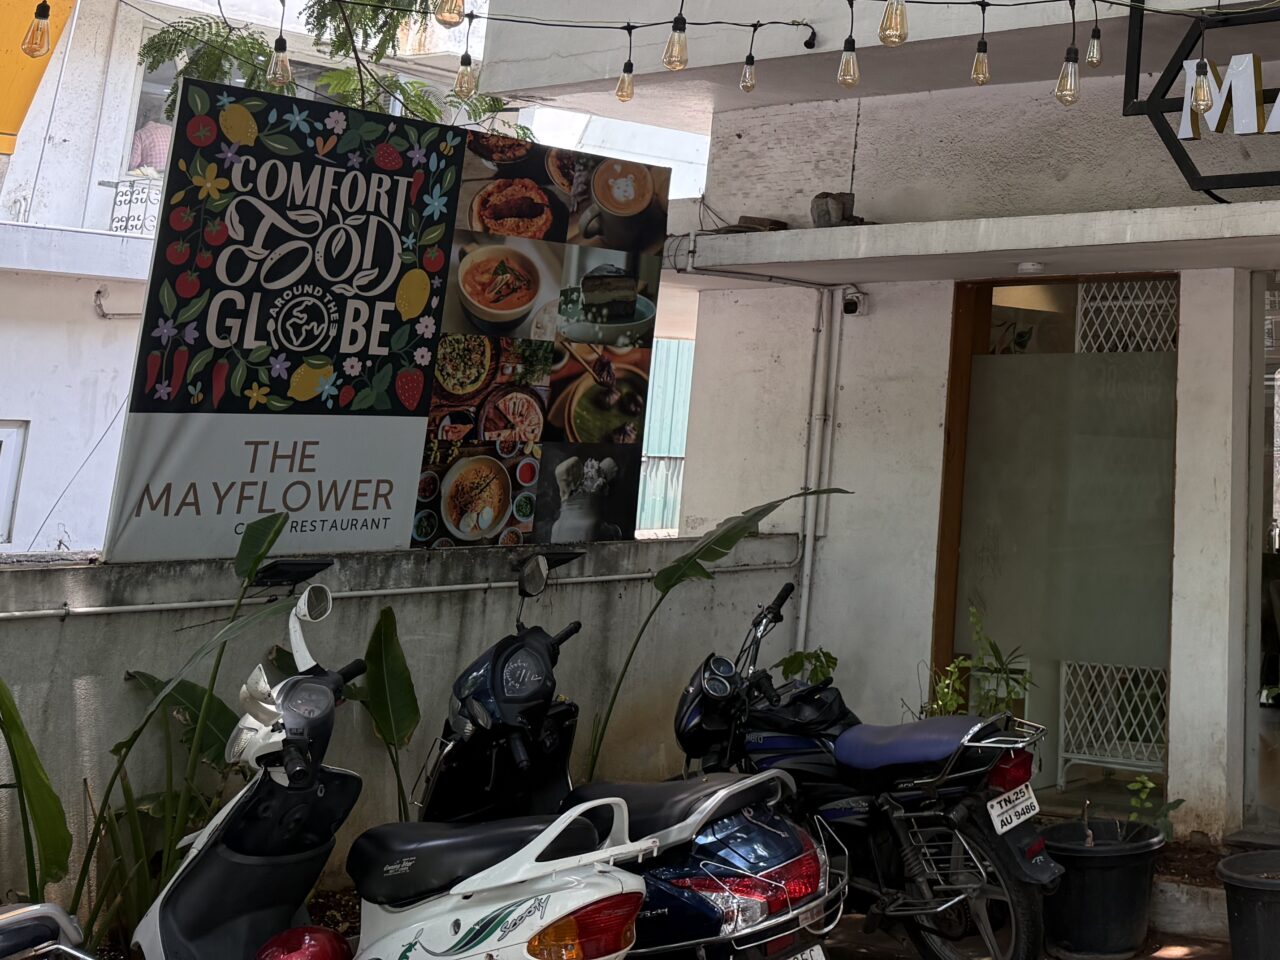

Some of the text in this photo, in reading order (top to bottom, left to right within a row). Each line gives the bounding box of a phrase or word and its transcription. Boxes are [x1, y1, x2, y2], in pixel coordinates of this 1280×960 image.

[231, 155, 414, 231] COMFORT
[215, 196, 402, 297] FOOD
[269, 284, 339, 321] AROUND THE
[244, 440, 320, 474] THE
[134, 478, 394, 517] MAYFLOWER
[289, 517, 391, 533] RESTAURANT
[1000, 802, 1037, 830] AU 9486
